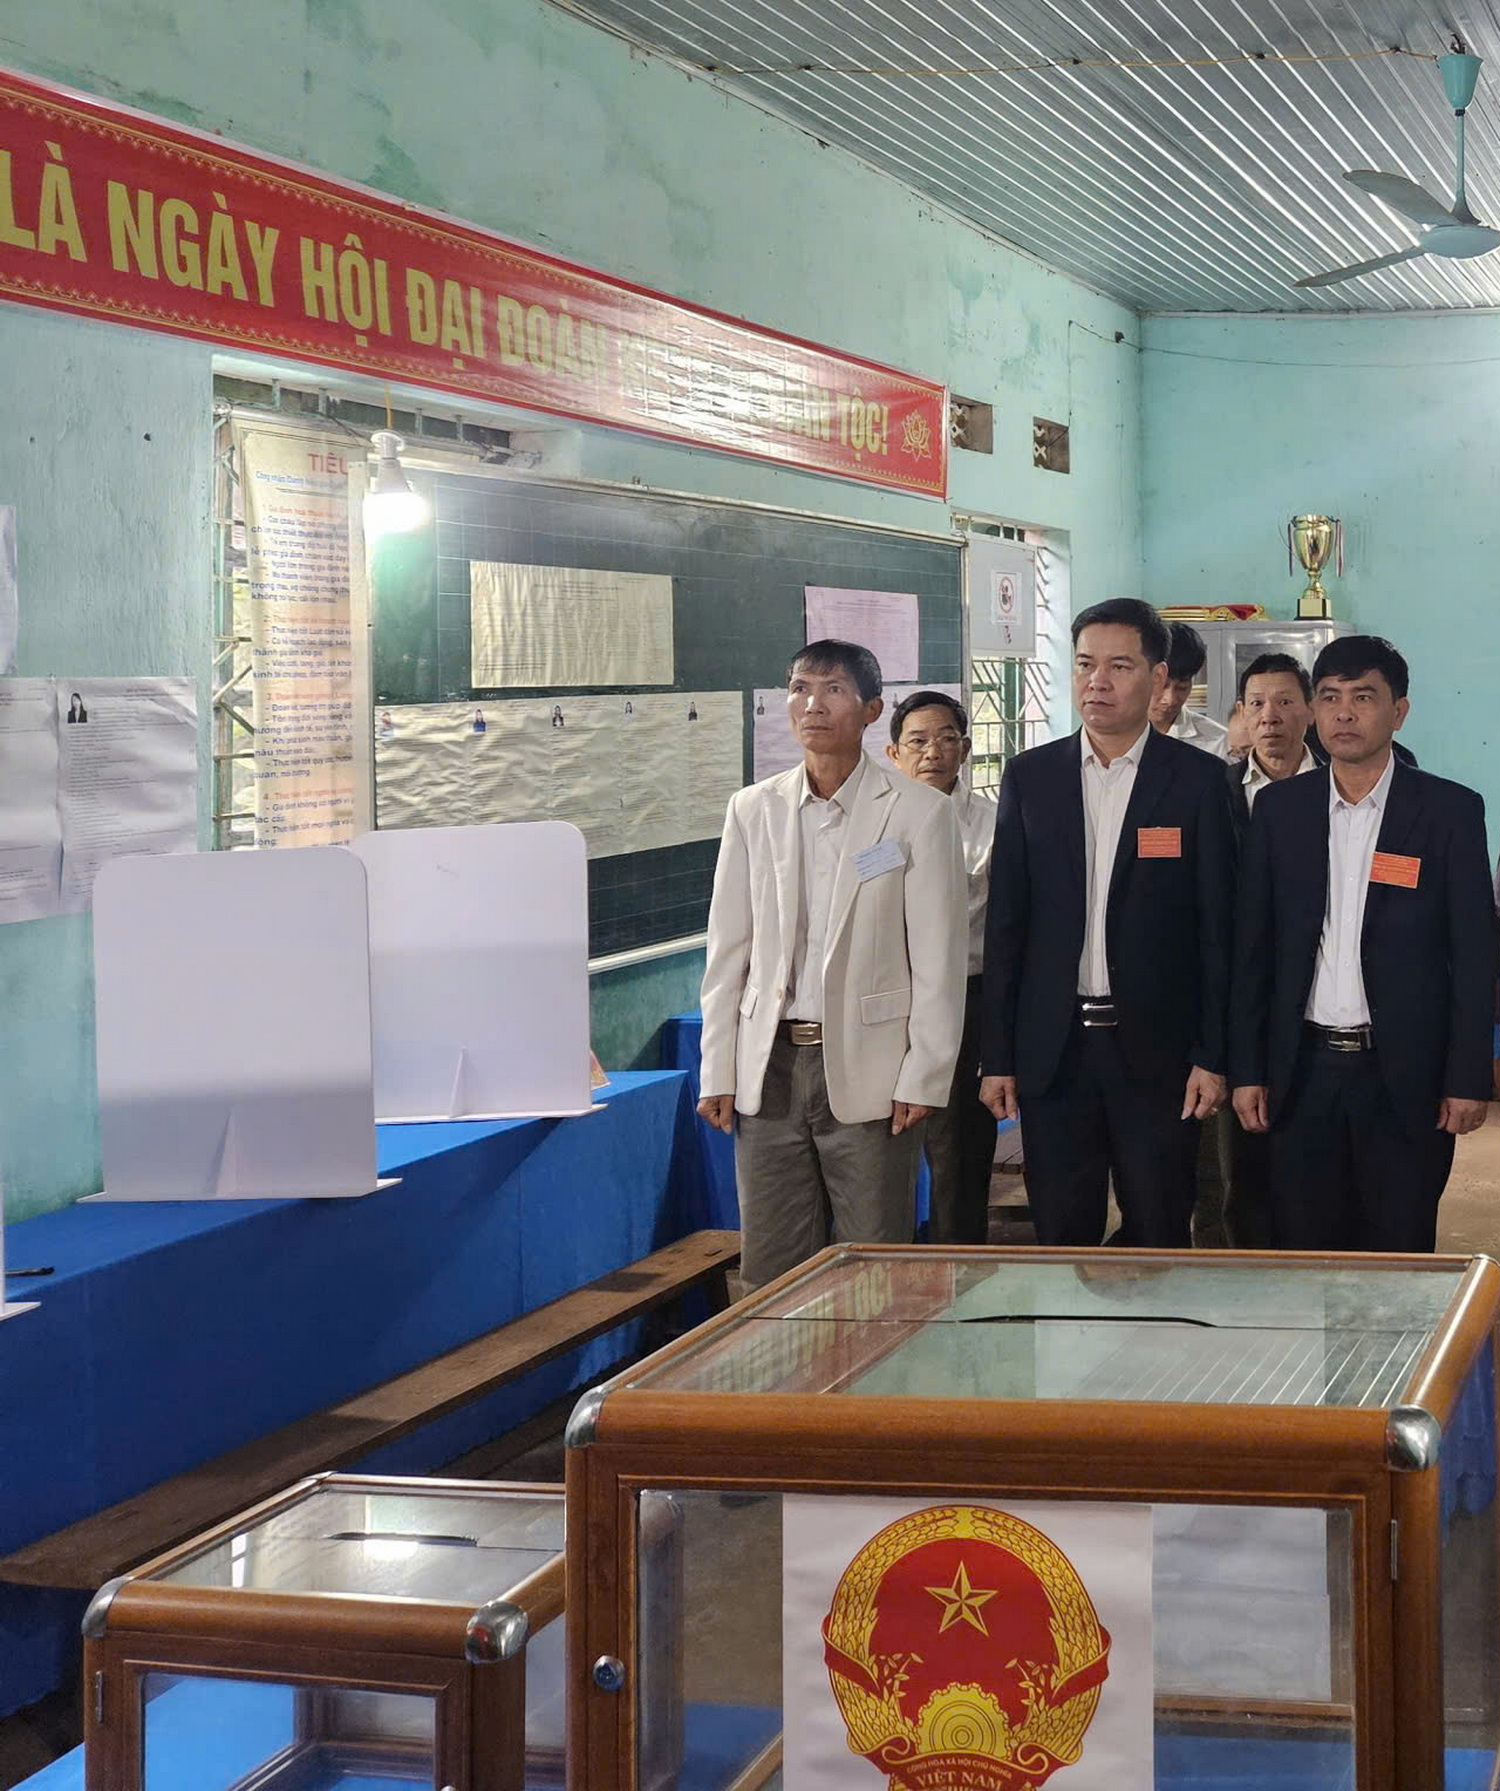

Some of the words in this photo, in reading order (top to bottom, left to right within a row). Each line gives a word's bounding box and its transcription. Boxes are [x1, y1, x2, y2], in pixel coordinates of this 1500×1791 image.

[0, 140, 87, 263] LÀ
[107, 180, 280, 307] NGÀY
[300, 233, 392, 347] HỘI
[406, 269, 487, 369] ĐẠI
[497, 294, 605, 384] ĐOÀN
[836, 385, 889, 462] TỘC!
[916, 1768, 957, 1787] VIỆT
[961, 1771, 1003, 1791] NAM
